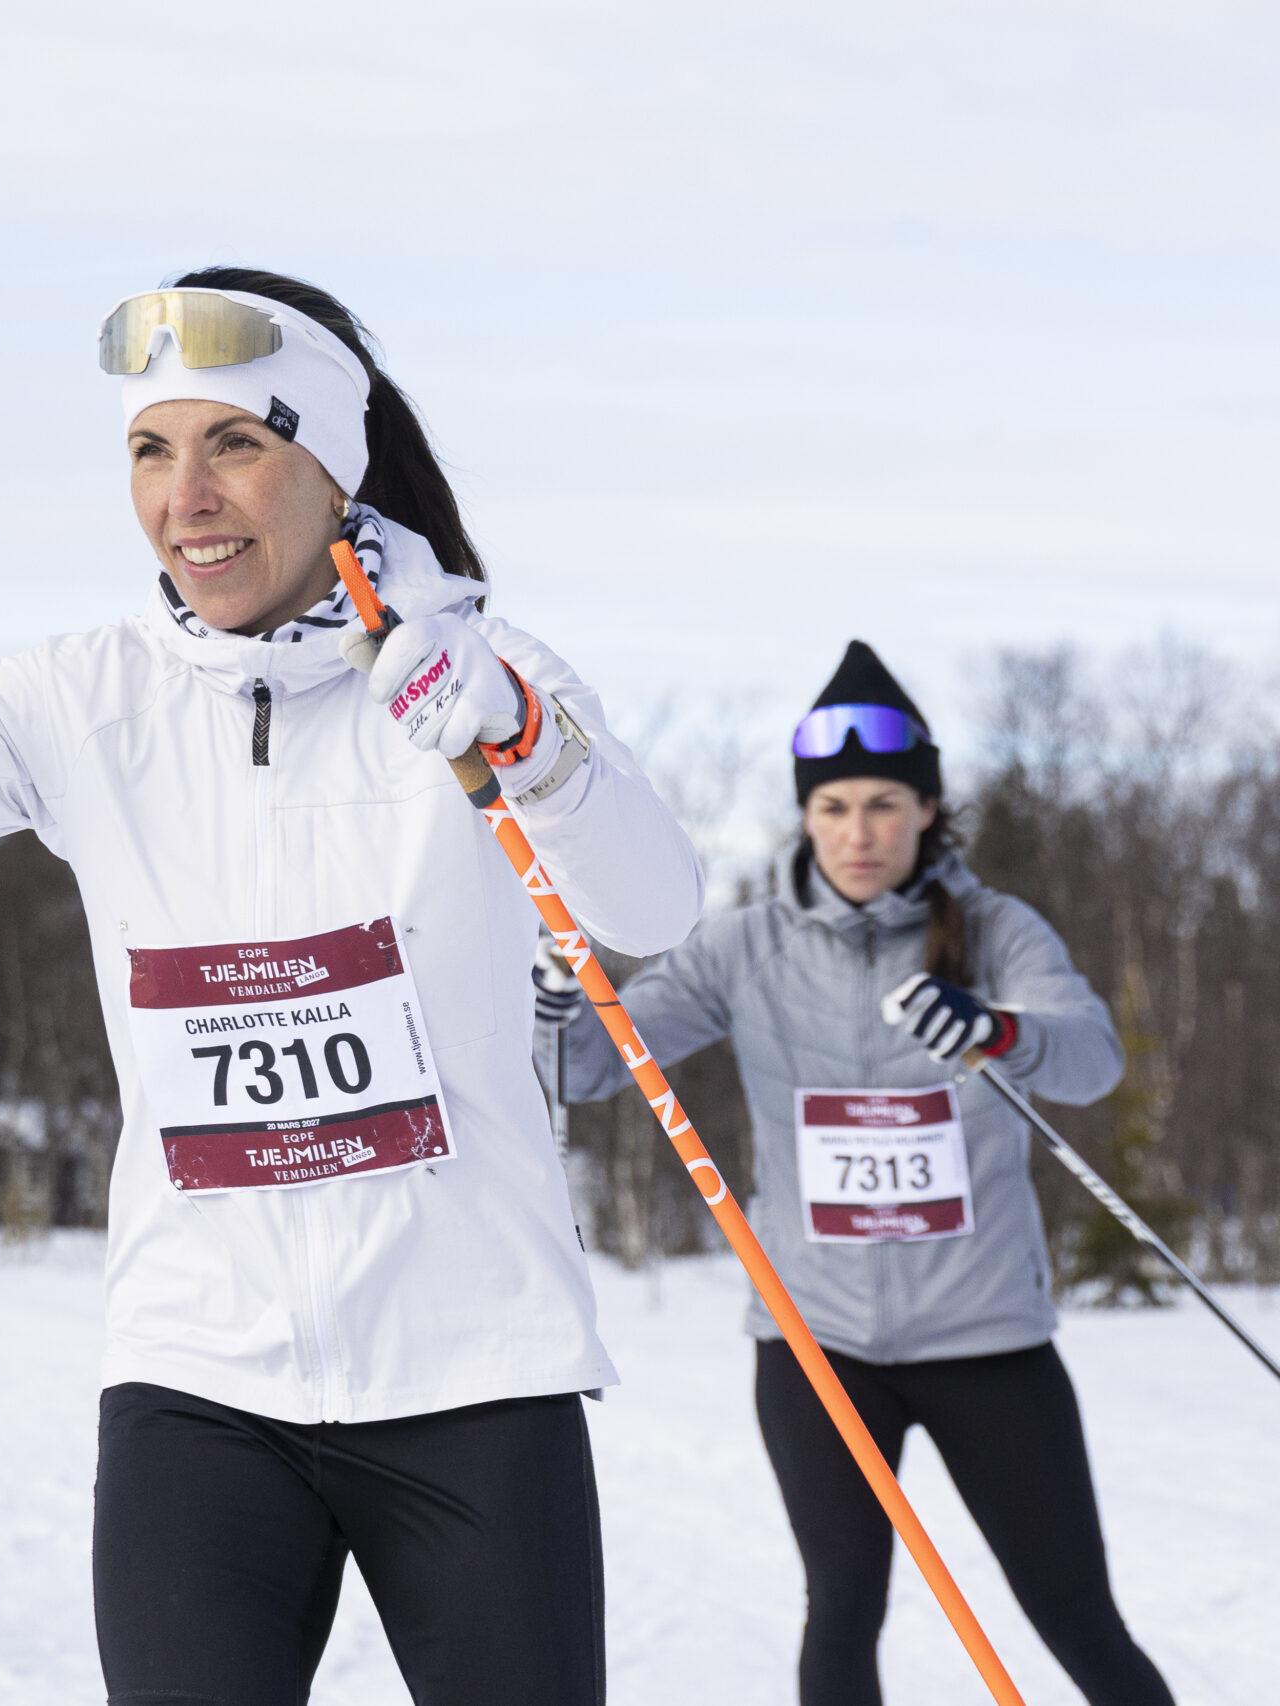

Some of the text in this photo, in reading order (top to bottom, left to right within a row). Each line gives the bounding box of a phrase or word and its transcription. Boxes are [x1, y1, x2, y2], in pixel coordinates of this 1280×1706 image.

[238, 948, 269, 959] EQPE
[200, 956, 317, 983] TJEJMILEN
[229, 982, 292, 998] VEMDALEN
[185, 1002, 352, 1035] CHARLOTTE KALLA
[402, 1001, 426, 1075] www.tjejmilen.se
[191, 1032, 372, 1106] 7310
[277, 1121, 301, 1130] MARS
[302, 1118, 320, 1128] 2027
[283, 1131, 315, 1144] EQPE
[245, 1136, 363, 1167] TJEJMILEN
[274, 1163, 338, 1181] VEMDALEN
[833, 1153, 931, 1192] 7313
